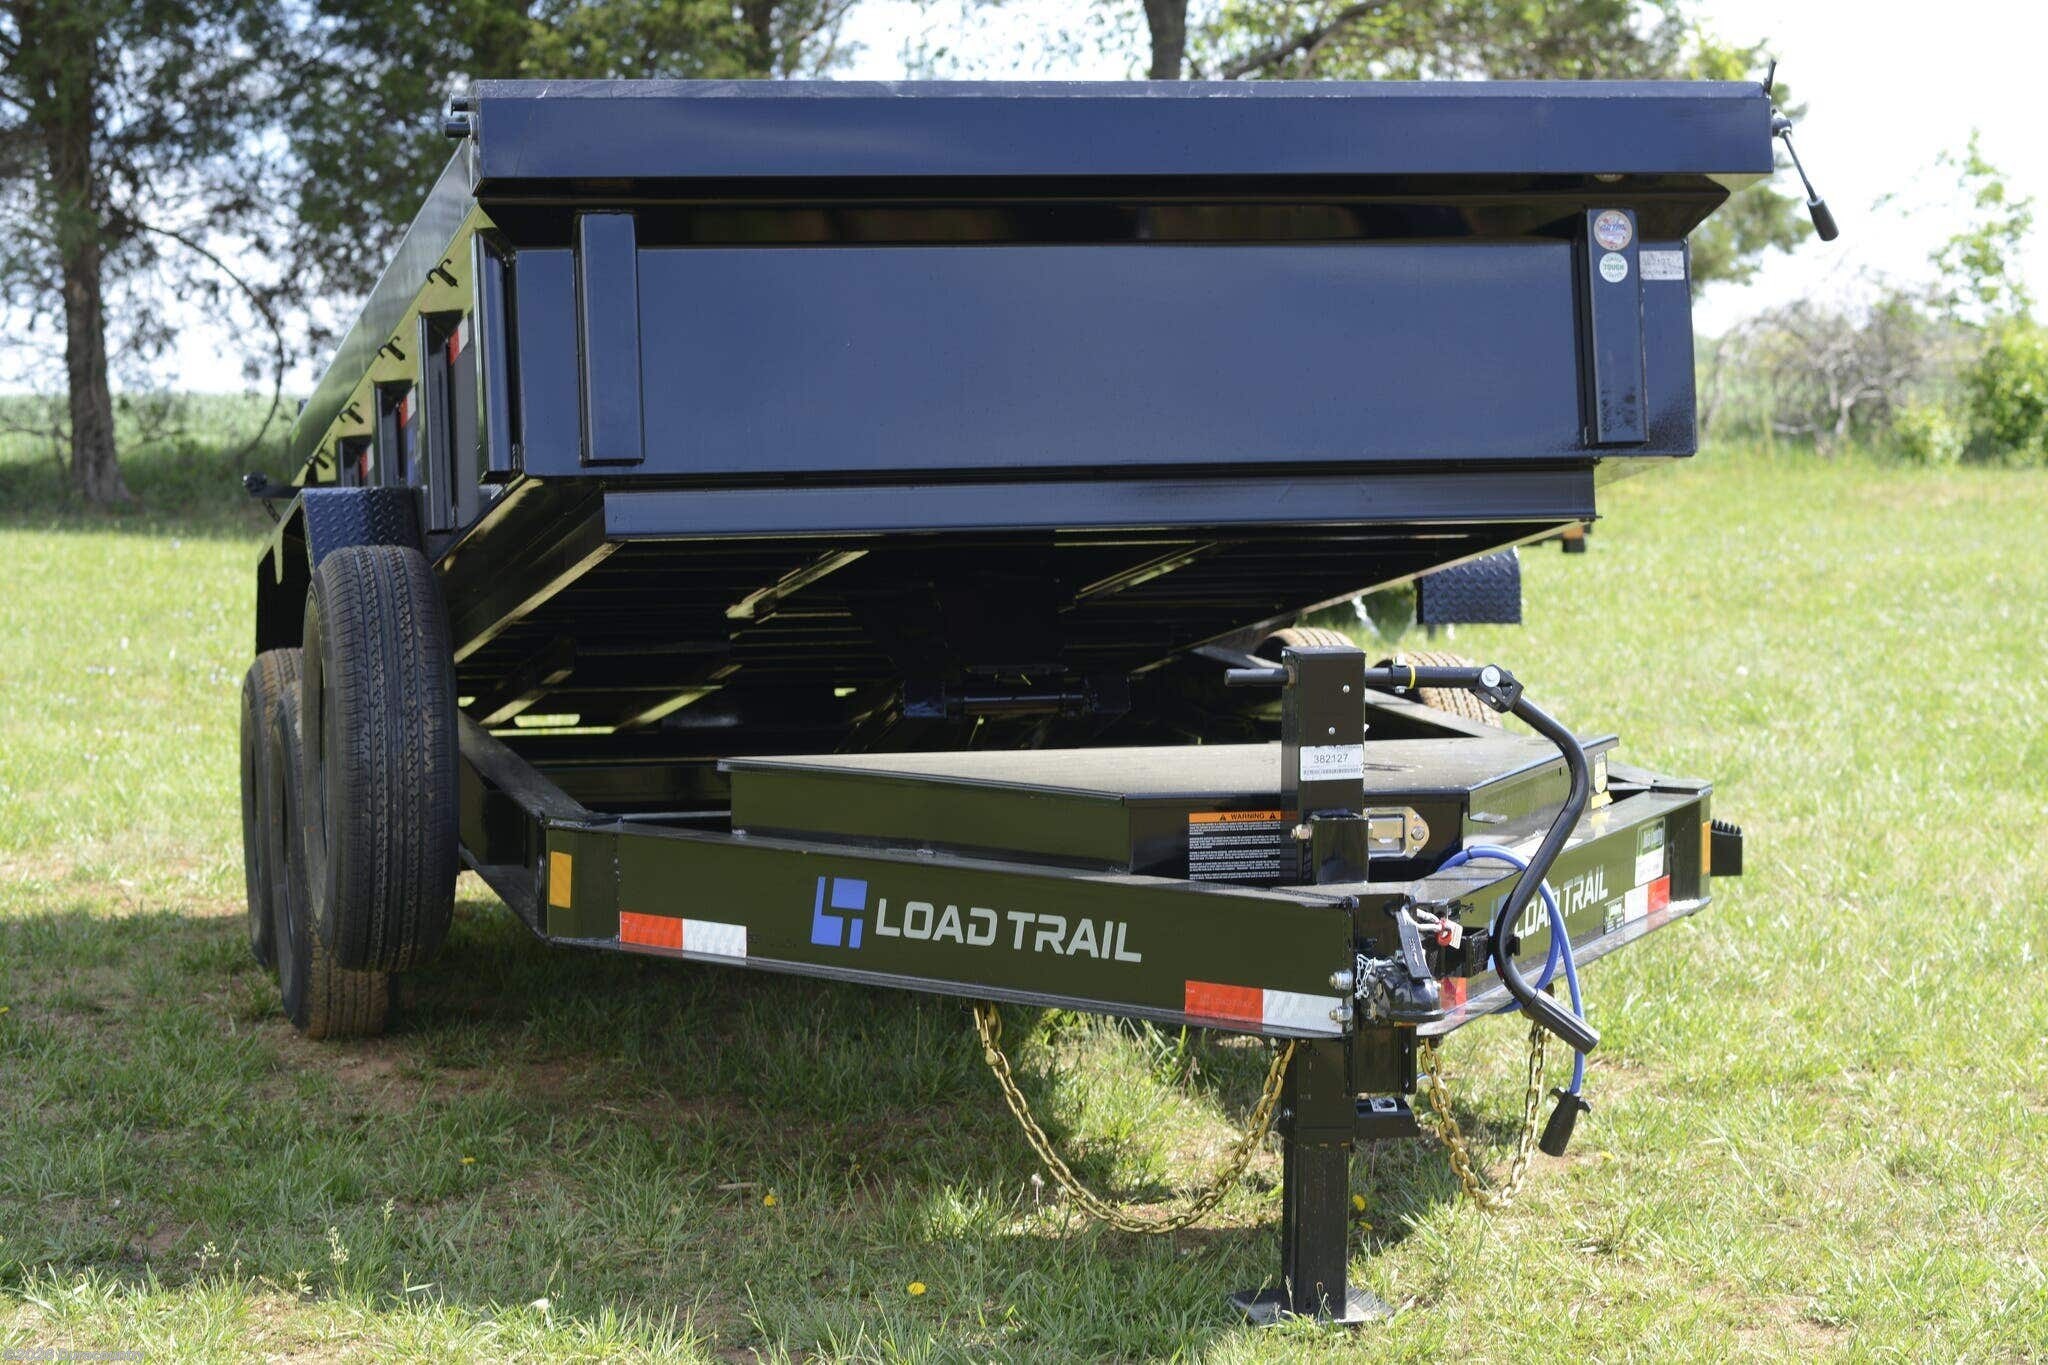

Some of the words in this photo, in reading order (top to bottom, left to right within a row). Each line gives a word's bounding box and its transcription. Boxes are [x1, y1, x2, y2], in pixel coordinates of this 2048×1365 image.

[1313, 752, 1349, 764] 382127
[1563, 864, 1608, 917] TRAIL
[875, 898, 997, 946] LOAD
[1007, 911, 1142, 963] TRAIL
